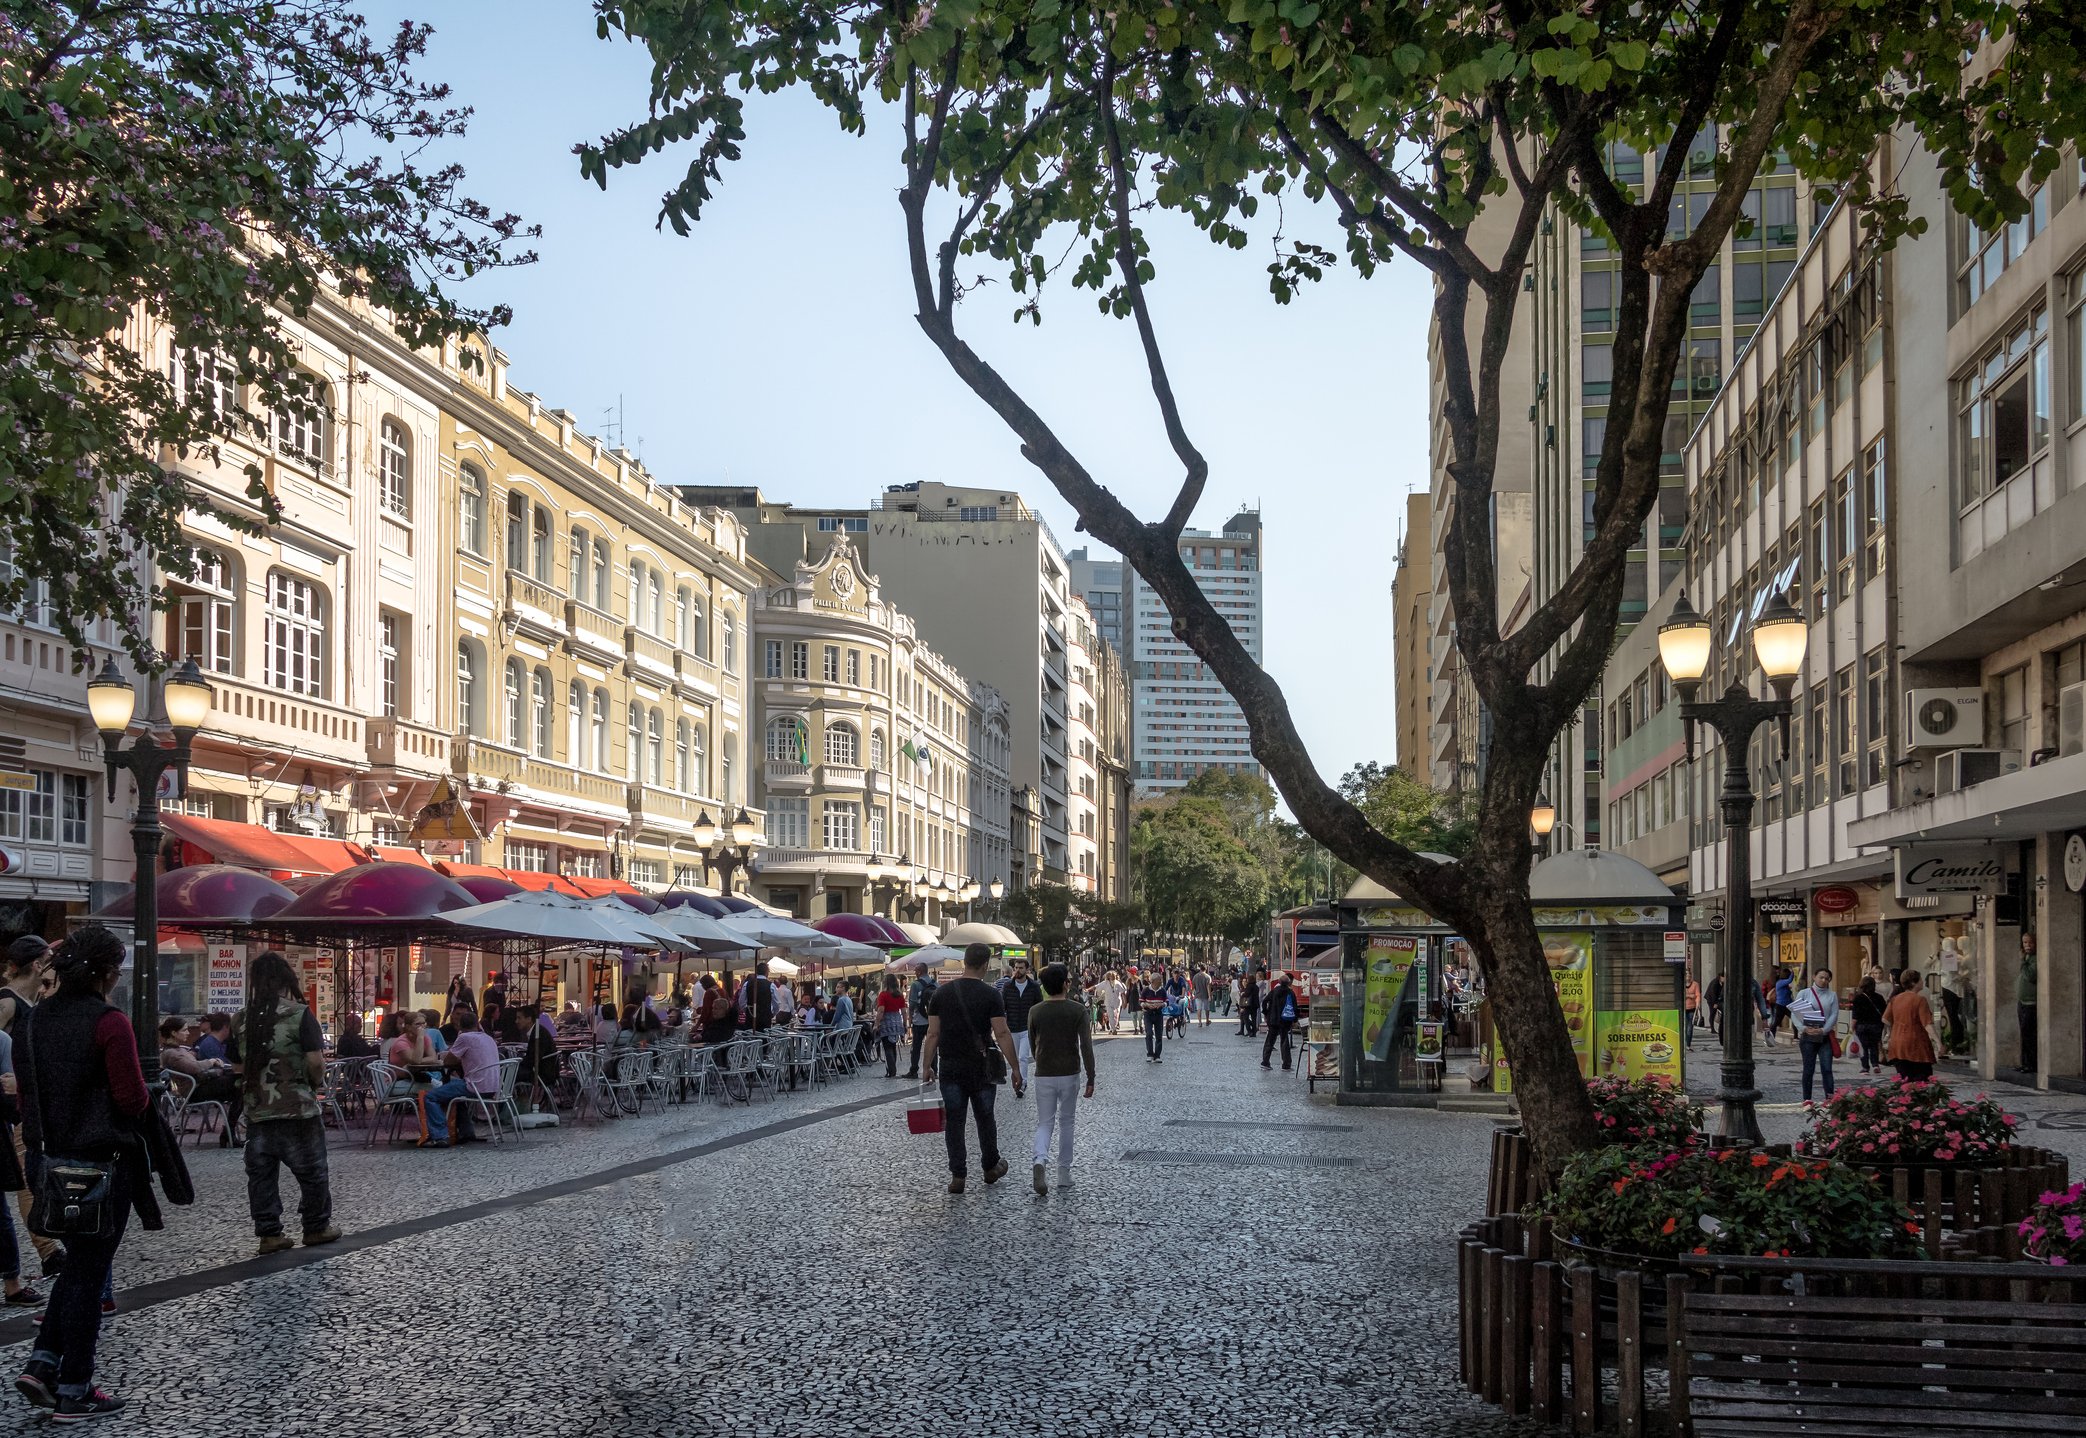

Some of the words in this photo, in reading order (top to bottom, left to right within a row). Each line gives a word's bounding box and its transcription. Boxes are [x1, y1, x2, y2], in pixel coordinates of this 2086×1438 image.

[1905, 858, 2002, 886] Camilo
[1760, 901, 1803, 913] dooplex
[1373, 938, 1413, 950] PROMOÇÃO
[219, 949, 234, 958] BAR
[1786, 942, 1798, 961] 20
[212, 959, 242, 968] MIGNON
[210, 971, 228, 979] ELEITO
[229, 971, 242, 979] PELA
[1554, 971, 1583, 981] Queijo
[210, 980, 229, 988] REVISTA
[230, 980, 242, 988] VEJA
[217, 989, 240, 997] MELHOR
[1562, 988, 1583, 996] 2,00
[1607, 1033, 1667, 1043] SOBREMESAS
